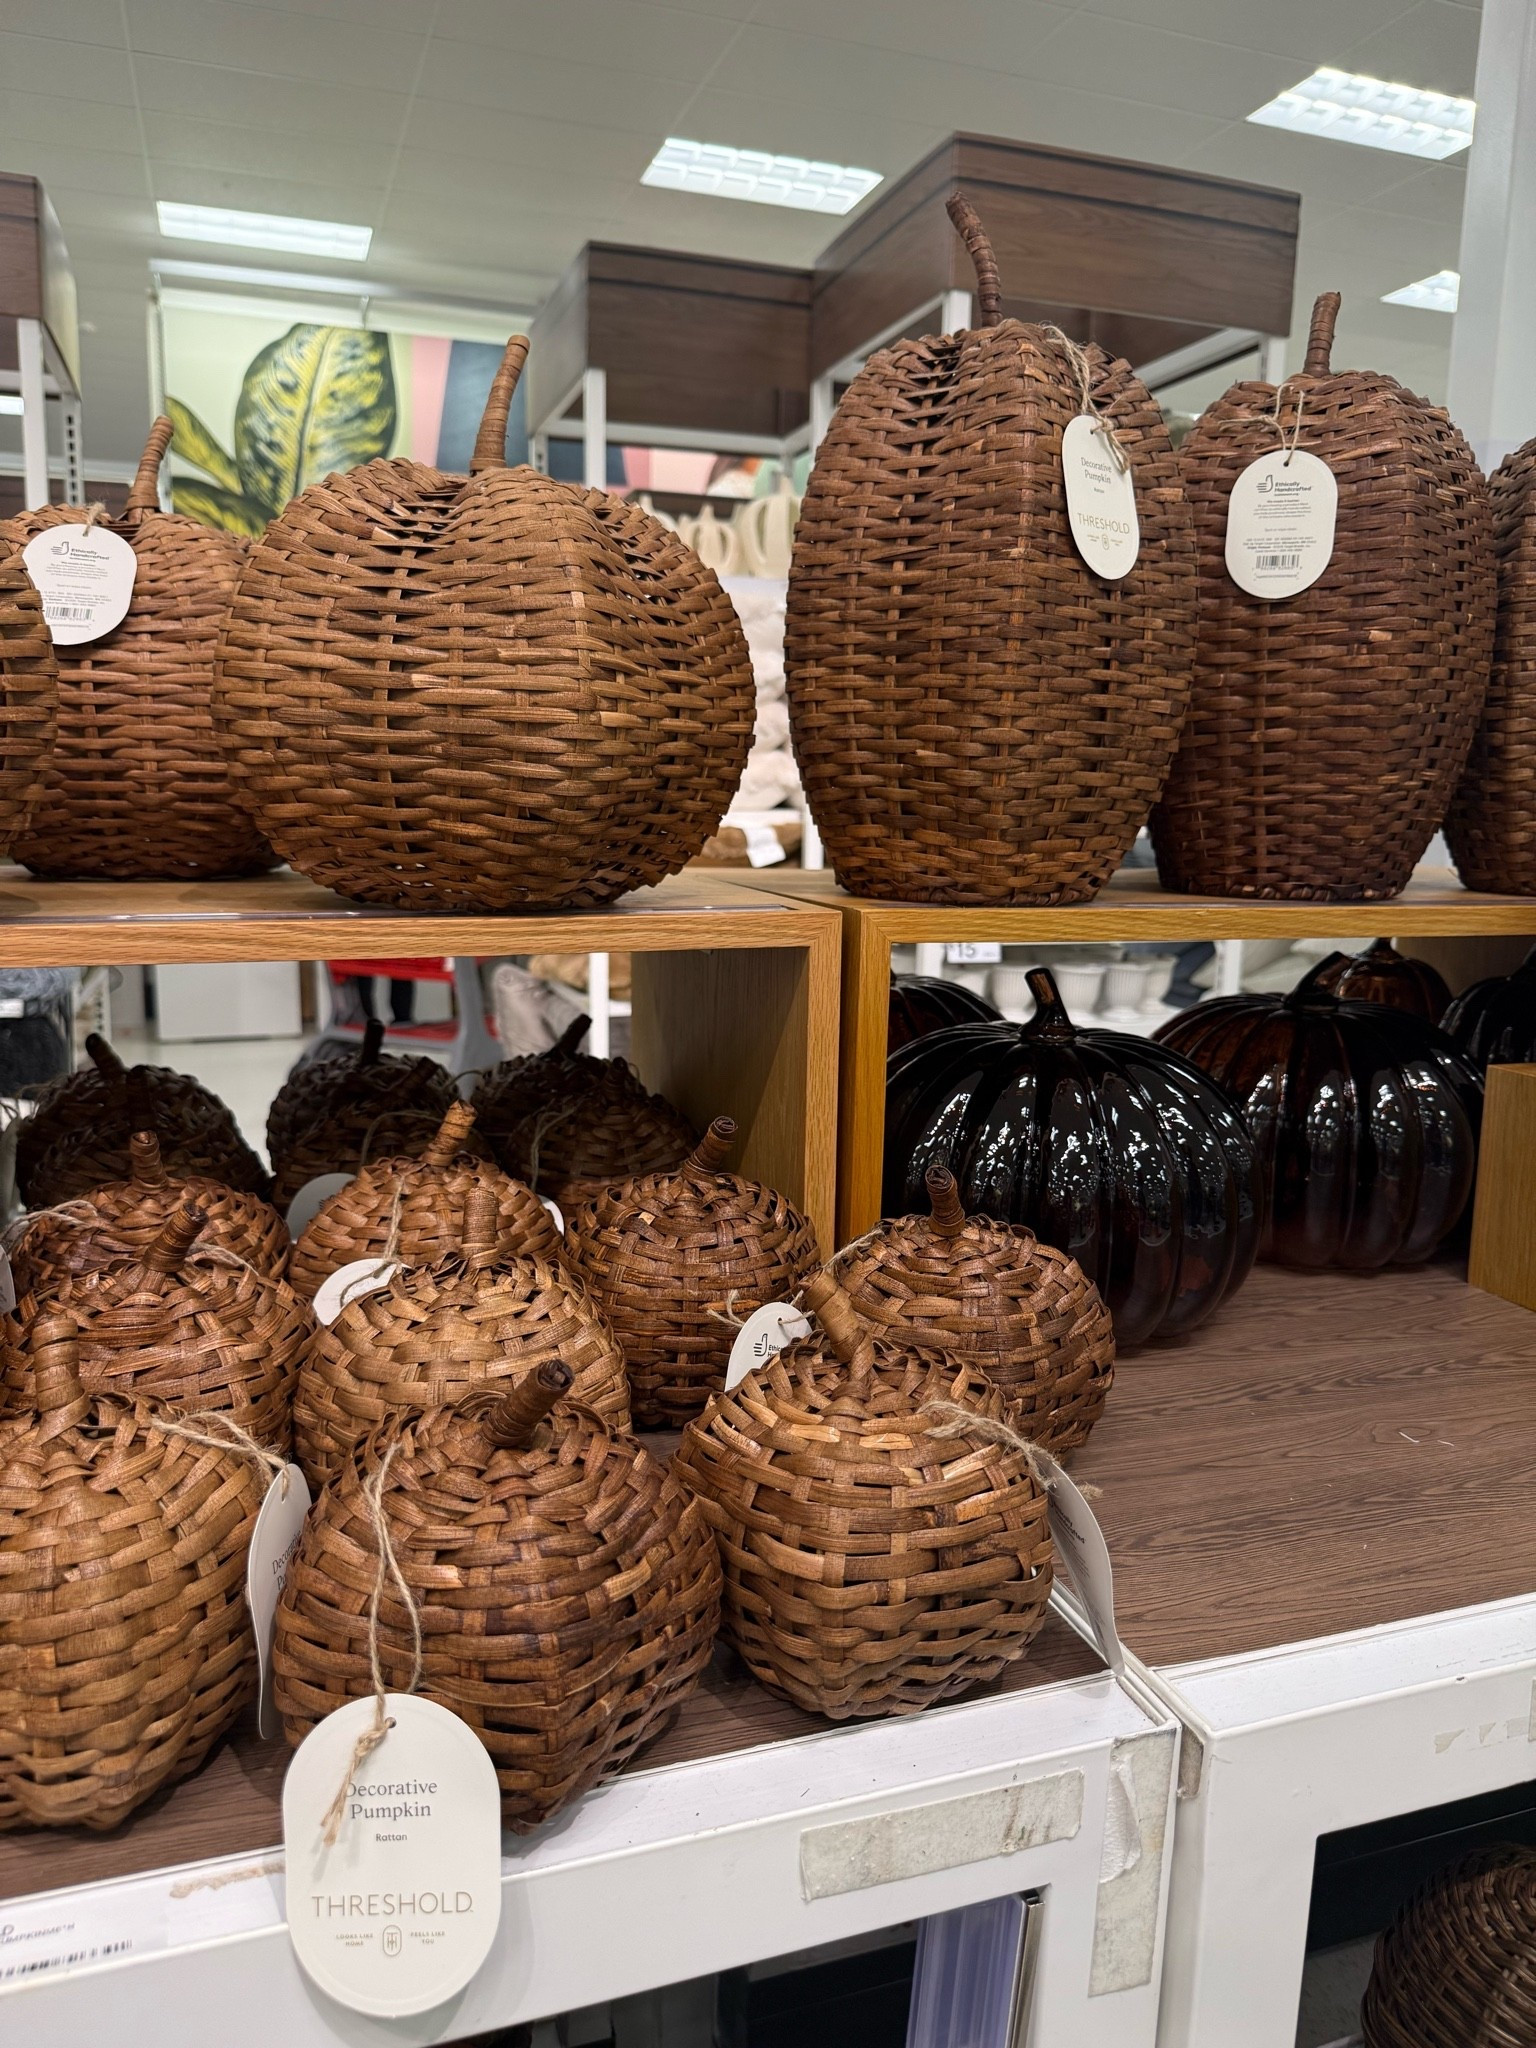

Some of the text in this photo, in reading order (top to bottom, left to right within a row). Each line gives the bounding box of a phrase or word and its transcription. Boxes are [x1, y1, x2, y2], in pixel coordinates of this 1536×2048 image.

[1080, 456, 1112, 473] Decorative
[1084, 469, 1112, 484] Pumpkin
[1077, 512, 1130, 534] THRESHOLD
[351, 1802, 432, 1821] Pumpkin
[375, 1833, 408, 1842] Rattan
[312, 1891, 473, 1917] THRESHOLD
